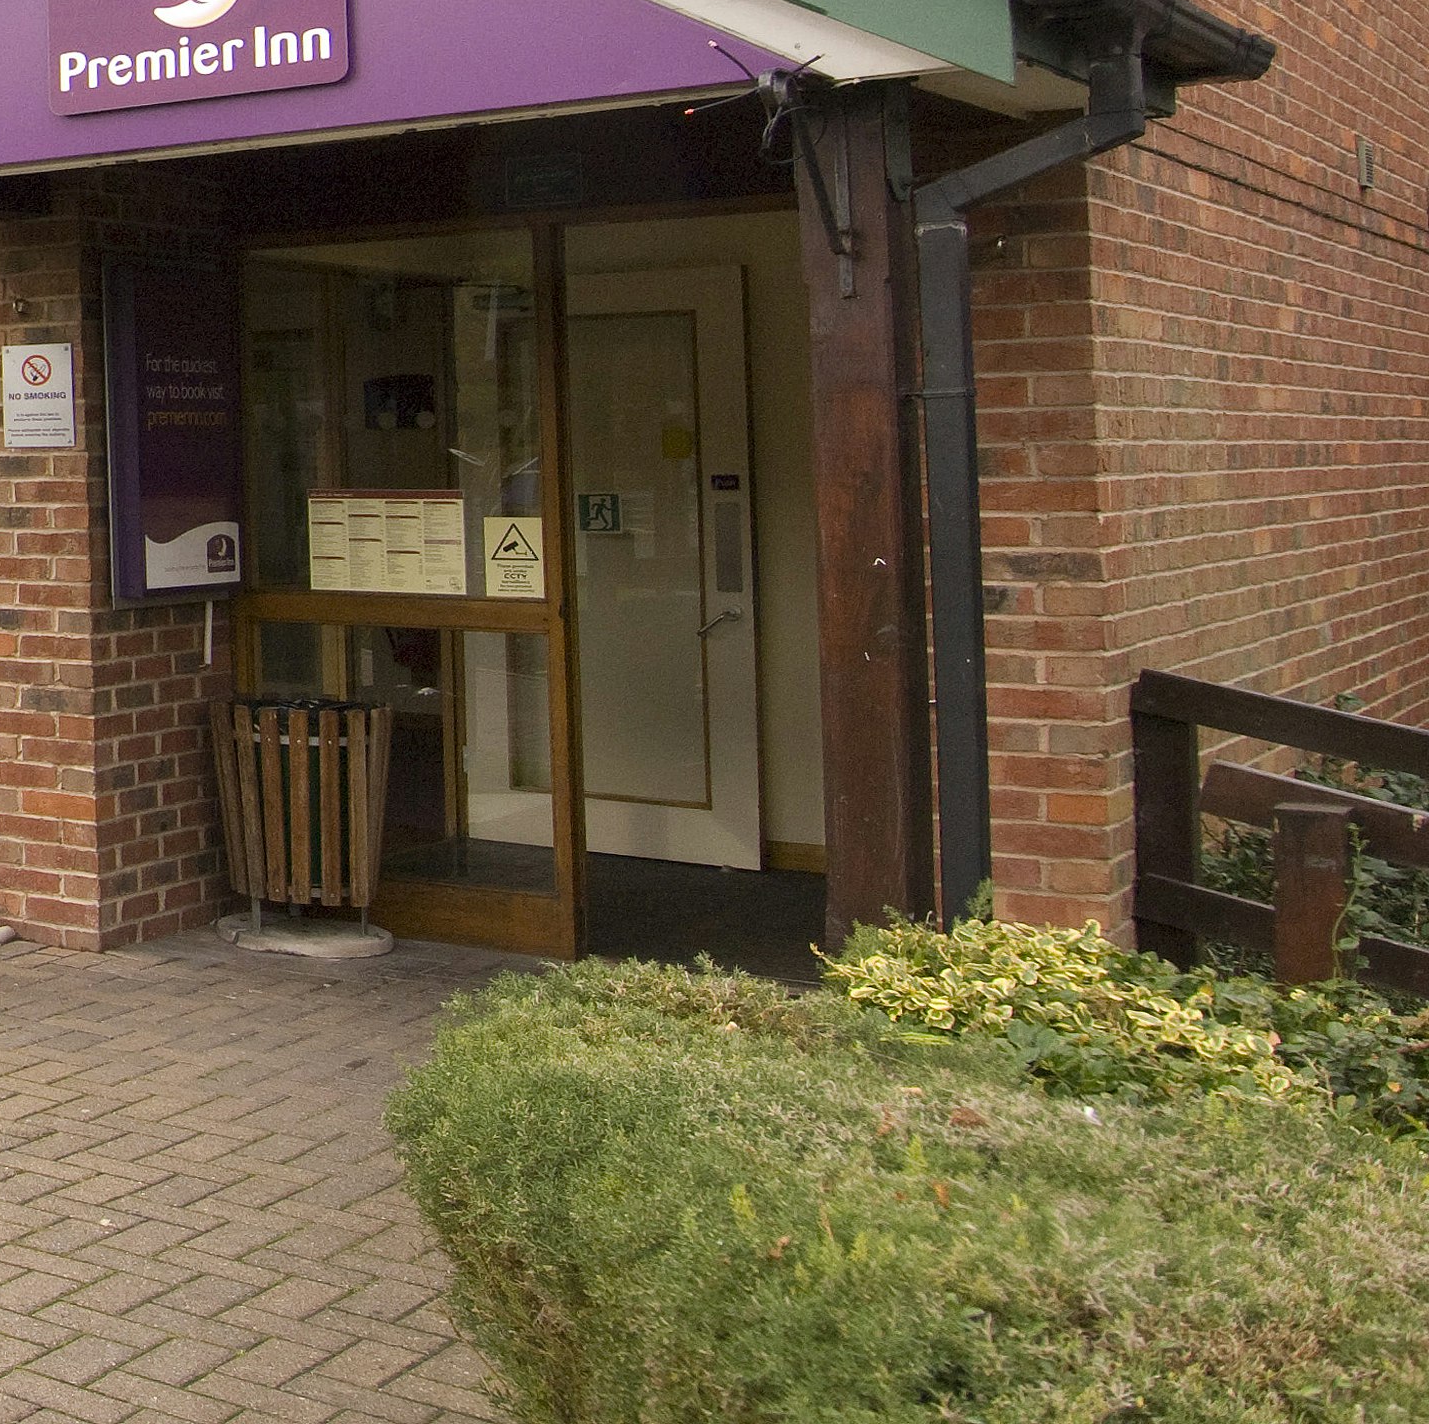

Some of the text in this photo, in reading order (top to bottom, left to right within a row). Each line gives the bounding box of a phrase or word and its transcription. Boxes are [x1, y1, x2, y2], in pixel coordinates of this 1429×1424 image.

[59, 26, 331, 92] Premier Inn
[146, 353, 162, 372] For
[164, 354, 180, 373] the
[24, 391, 67, 400] SMOKING
[146, 384, 167, 404] way
[168, 384, 180, 399] to
[181, 381, 206, 399] book
